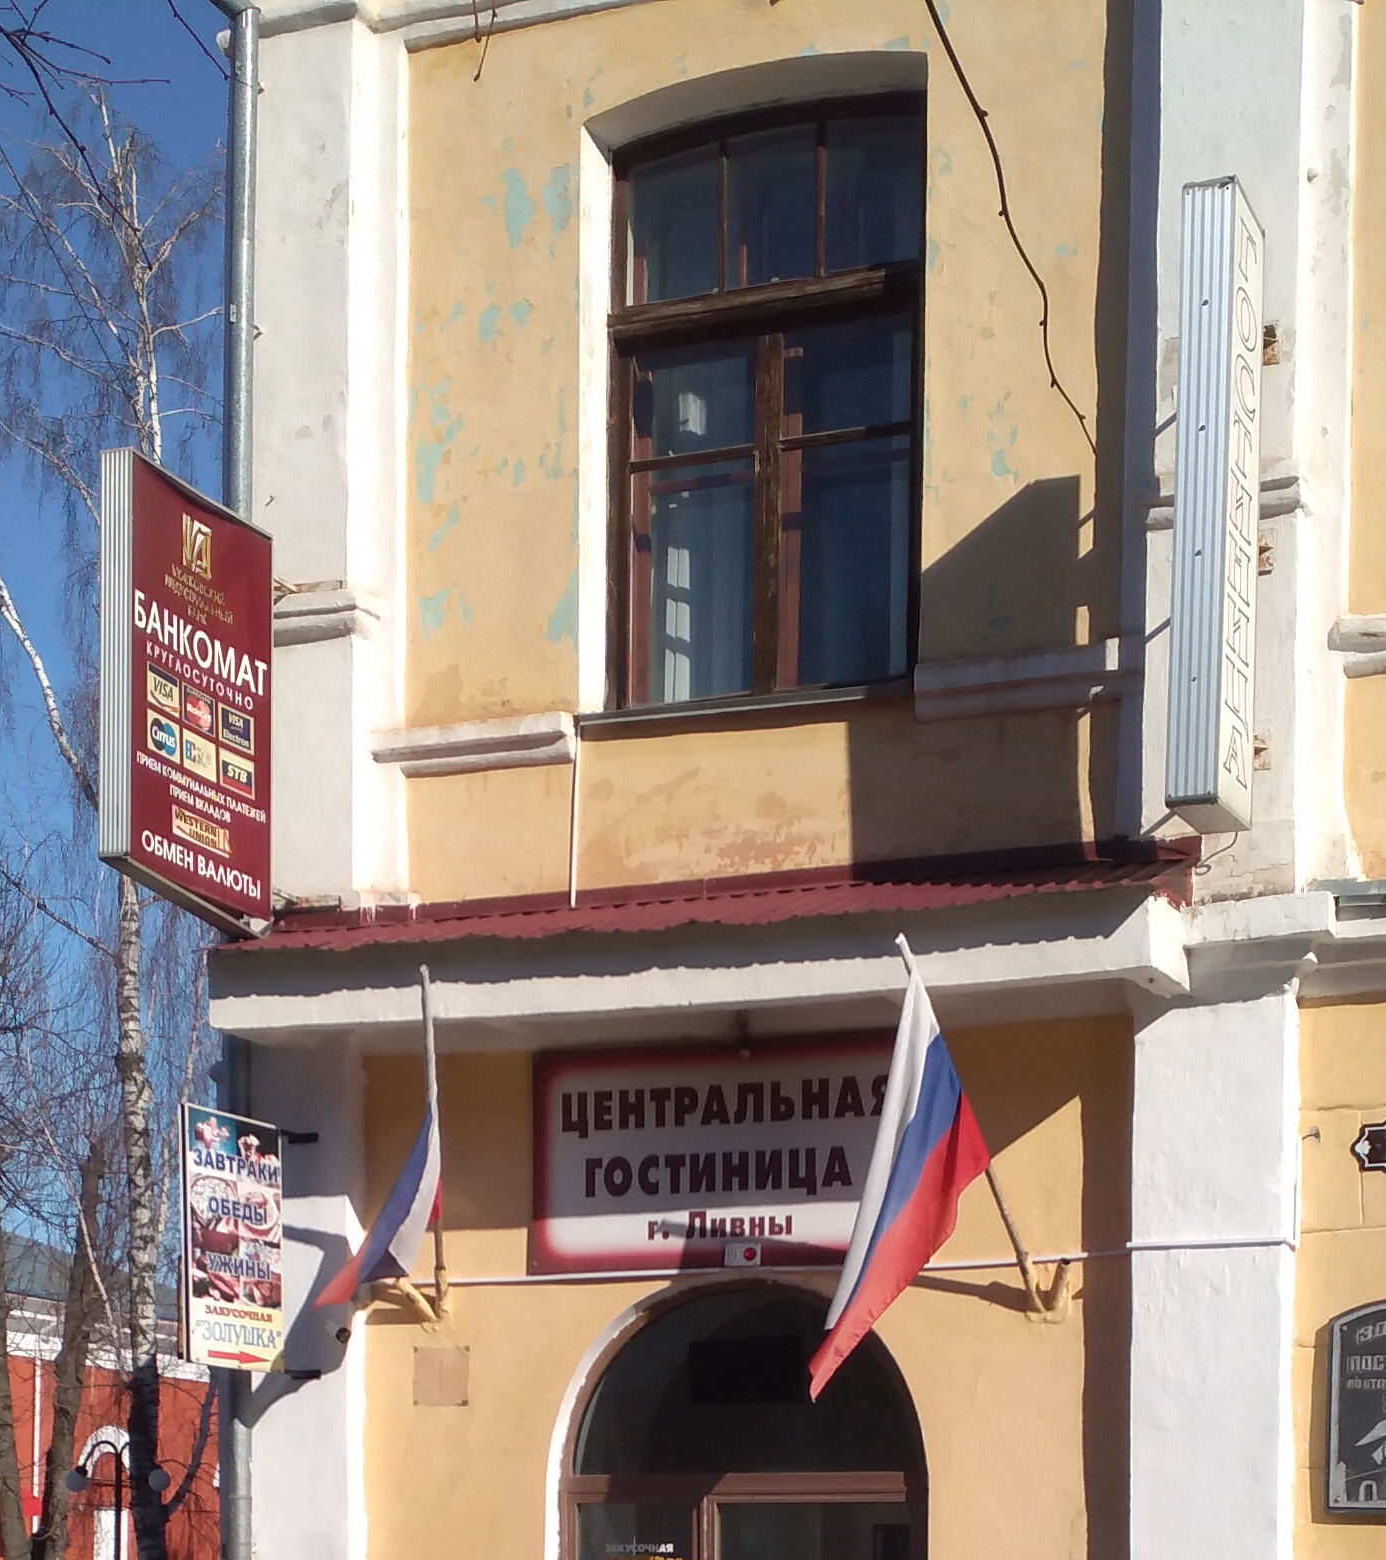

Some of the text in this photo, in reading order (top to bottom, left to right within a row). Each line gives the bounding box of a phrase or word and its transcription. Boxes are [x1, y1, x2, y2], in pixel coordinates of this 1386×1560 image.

[1221, 216, 1258, 791] ГОСТИНИЦА
[134, 588, 269, 697] БАНКОМАТ
[146, 639, 254, 711] КРУГЛОСУТОЧНО
[153, 677, 175, 702] VISA
[222, 728, 250, 748] Electron
[136, 750, 267, 824] ПРИЕМ КОММУНАЛЬНЫХ ПЛАТЕЖЕЙ
[226, 764, 248, 784] STB
[169, 783, 232, 823] ПРИЕМ ВКЛАДОВ
[174, 809, 217, 837] WESTERN
[141, 829, 261, 900] ОБМЕН ВАЛЮТЫ
[193, 1147, 280, 1183] ЗАВТРАКИ
[584, 1145, 853, 1198] ГОСТИНИЦА
[207, 1196, 268, 1225] ОБЕДЫ
[686, 1210, 793, 1240] Ливны
[207, 1252, 271, 1281] УЖИНЫ
[204, 1303, 273, 1324] ЗАКУСОЧНАЯ
[196, 1319, 283, 1349] "ЗОЛУШКА"
[604, 1543, 674, 1553] ЗАКУСОЧНАЯ
